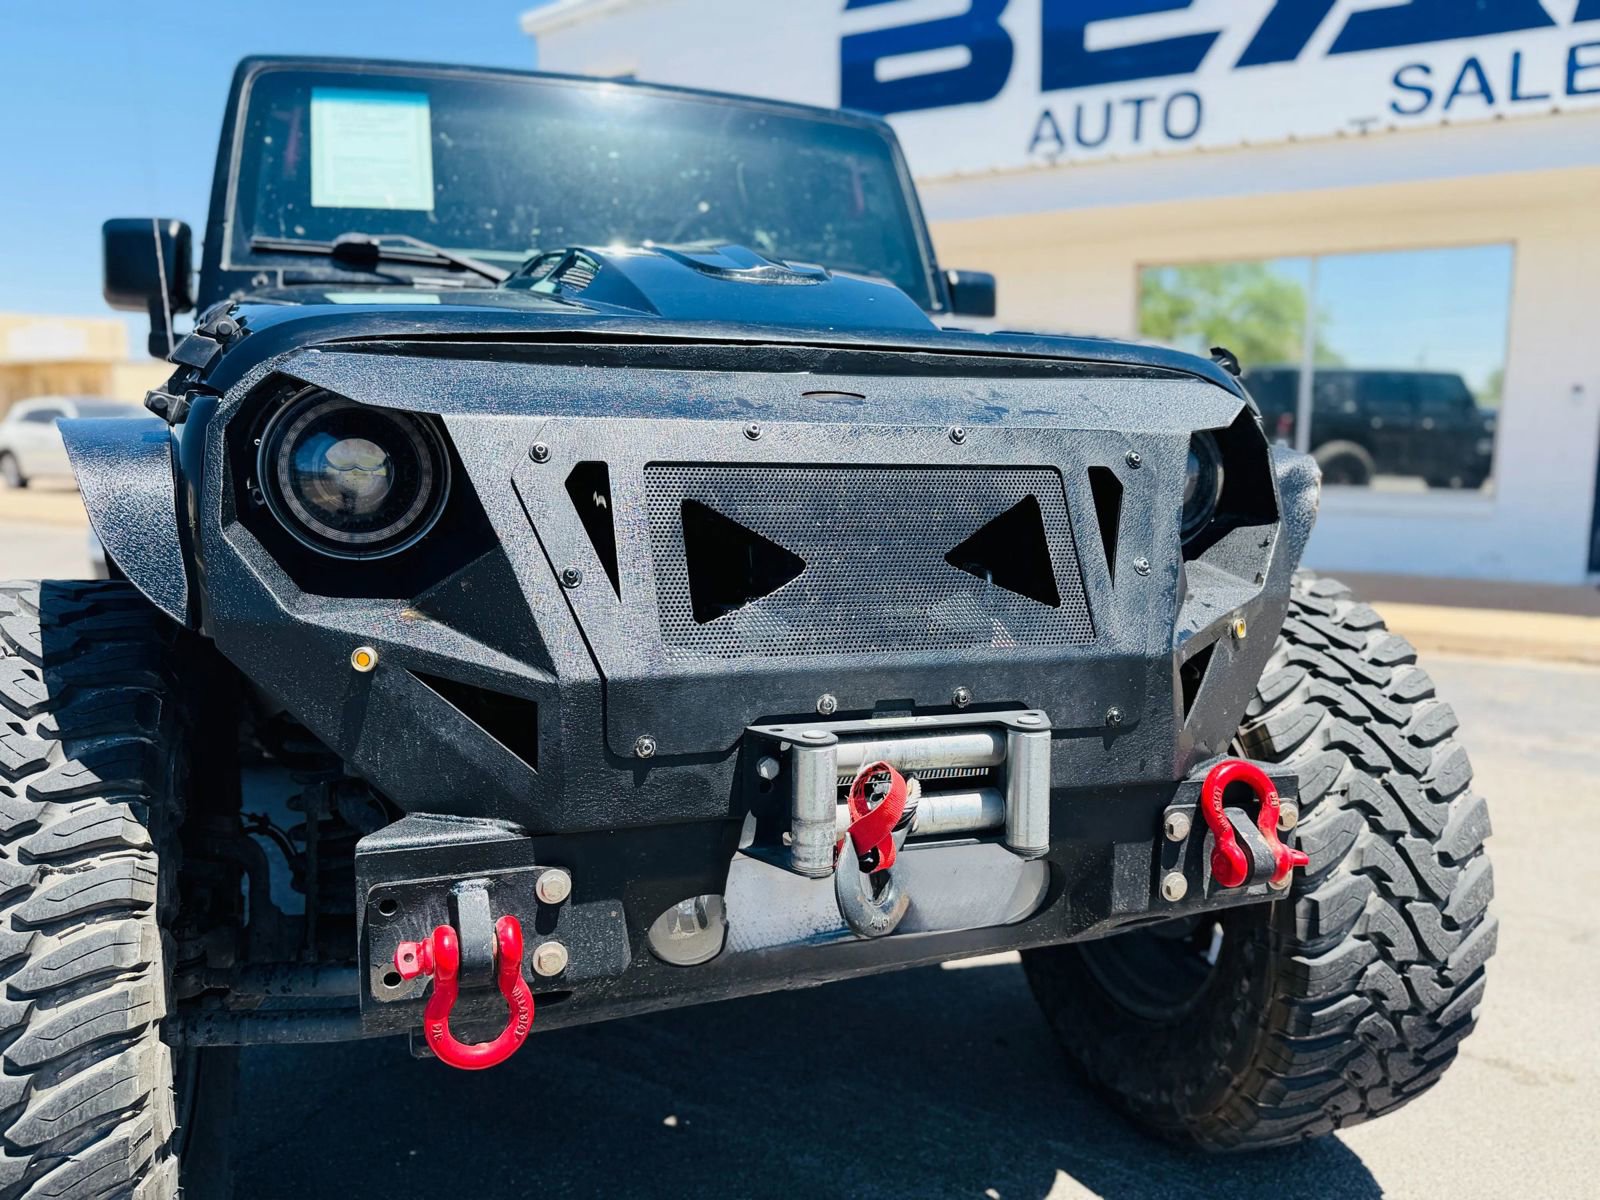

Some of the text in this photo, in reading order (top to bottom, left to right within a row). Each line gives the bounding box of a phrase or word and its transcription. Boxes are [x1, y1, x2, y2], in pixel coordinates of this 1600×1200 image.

[840, 0, 1600, 117] BE
[1028, 41, 1600, 152] AUTO SALE
